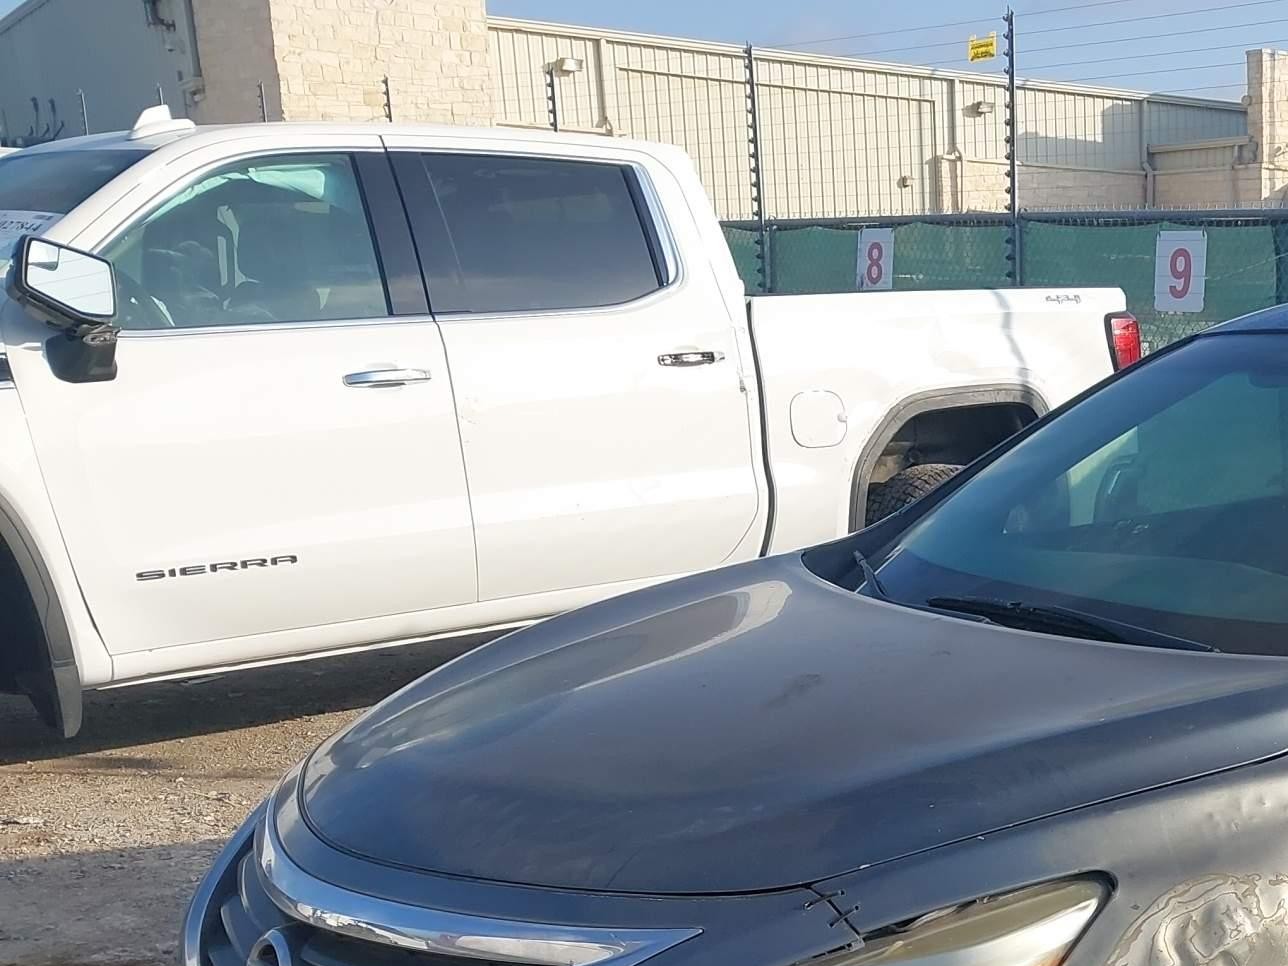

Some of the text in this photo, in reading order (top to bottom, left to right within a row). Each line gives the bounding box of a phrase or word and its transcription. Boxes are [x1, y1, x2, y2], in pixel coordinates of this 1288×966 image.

[867, 242, 883, 285] 8
[1169, 248, 1192, 299] 9
[136, 555, 298, 581] SIERRA
